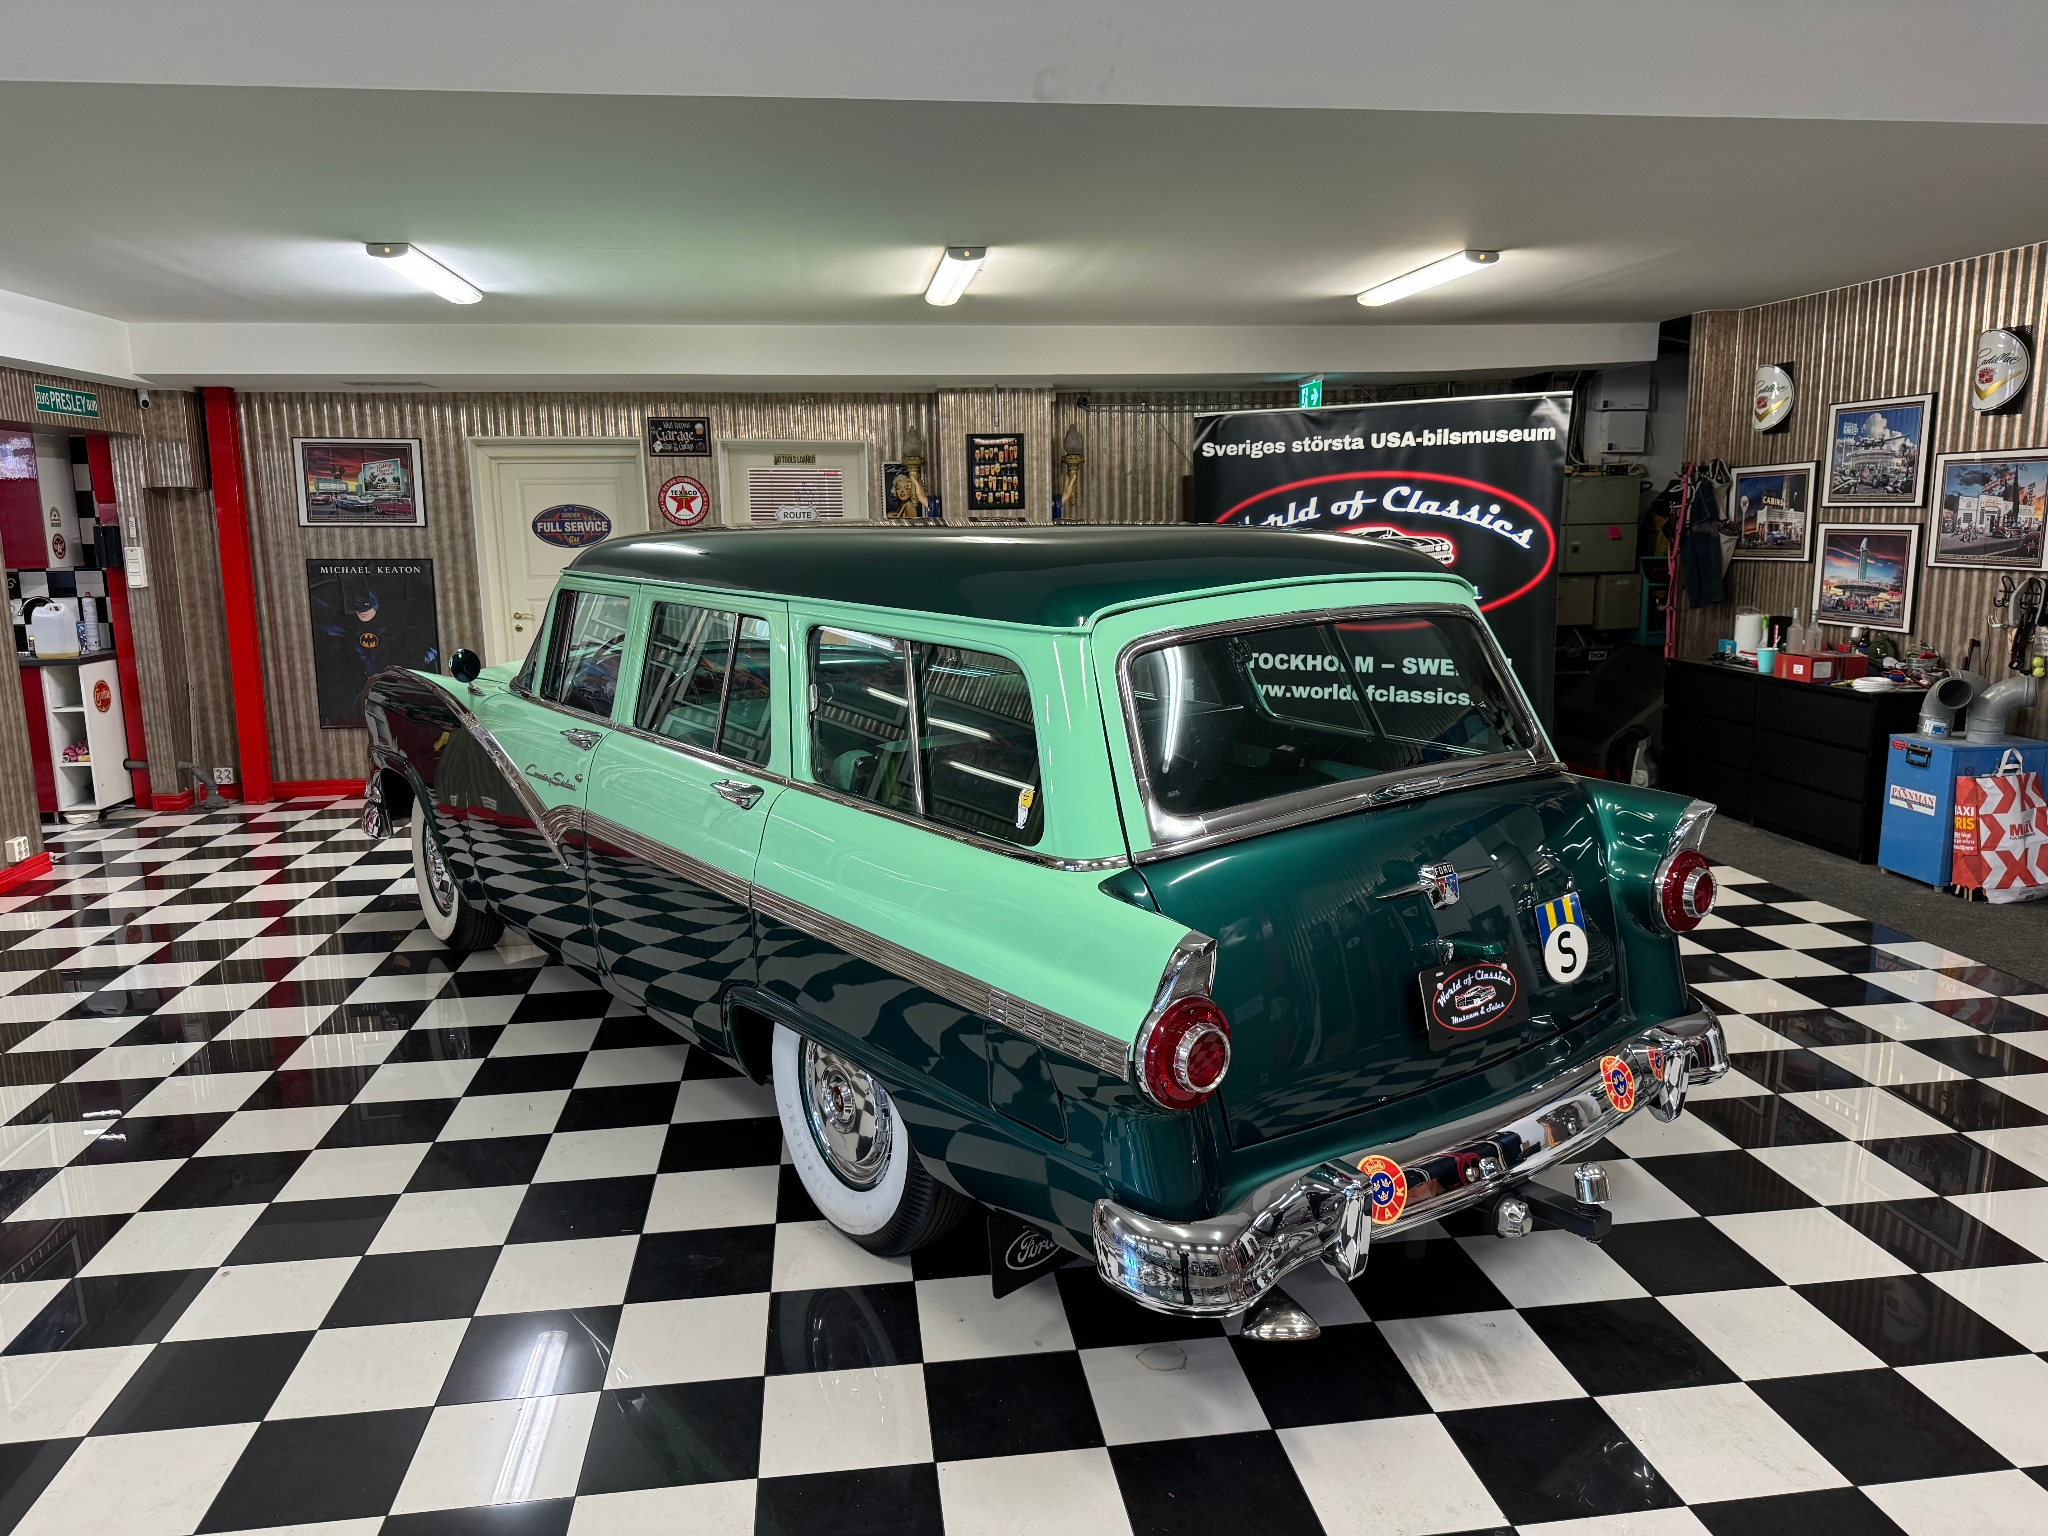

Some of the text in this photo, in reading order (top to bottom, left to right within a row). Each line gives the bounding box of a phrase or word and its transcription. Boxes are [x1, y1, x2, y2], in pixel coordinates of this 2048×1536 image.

[49, 391, 86, 412] PRESLEY
[86, 399, 98, 412] BLVD
[1202, 425, 1556, 459] Sveriges största USA-bilsmuseum
[1762, 496, 1784, 507] CABINS
[783, 511, 812, 519] ROUTE
[1331, 490, 1377, 520] of
[1383, 485, 1534, 549] Classics
[537, 521, 608, 533] FULL SERVICE
[320, 566, 421, 574] MICHAEL KEATON
[1892, 787, 1934, 806] PANNMAN
[1434, 865, 1452, 875] FORD
[1557, 931, 1577, 974] S
[1437, 969, 1512, 1008] World of Classics
[1450, 1011, 1480, 1025] Museum
[1486, 1001, 1506, 1013] Sales
